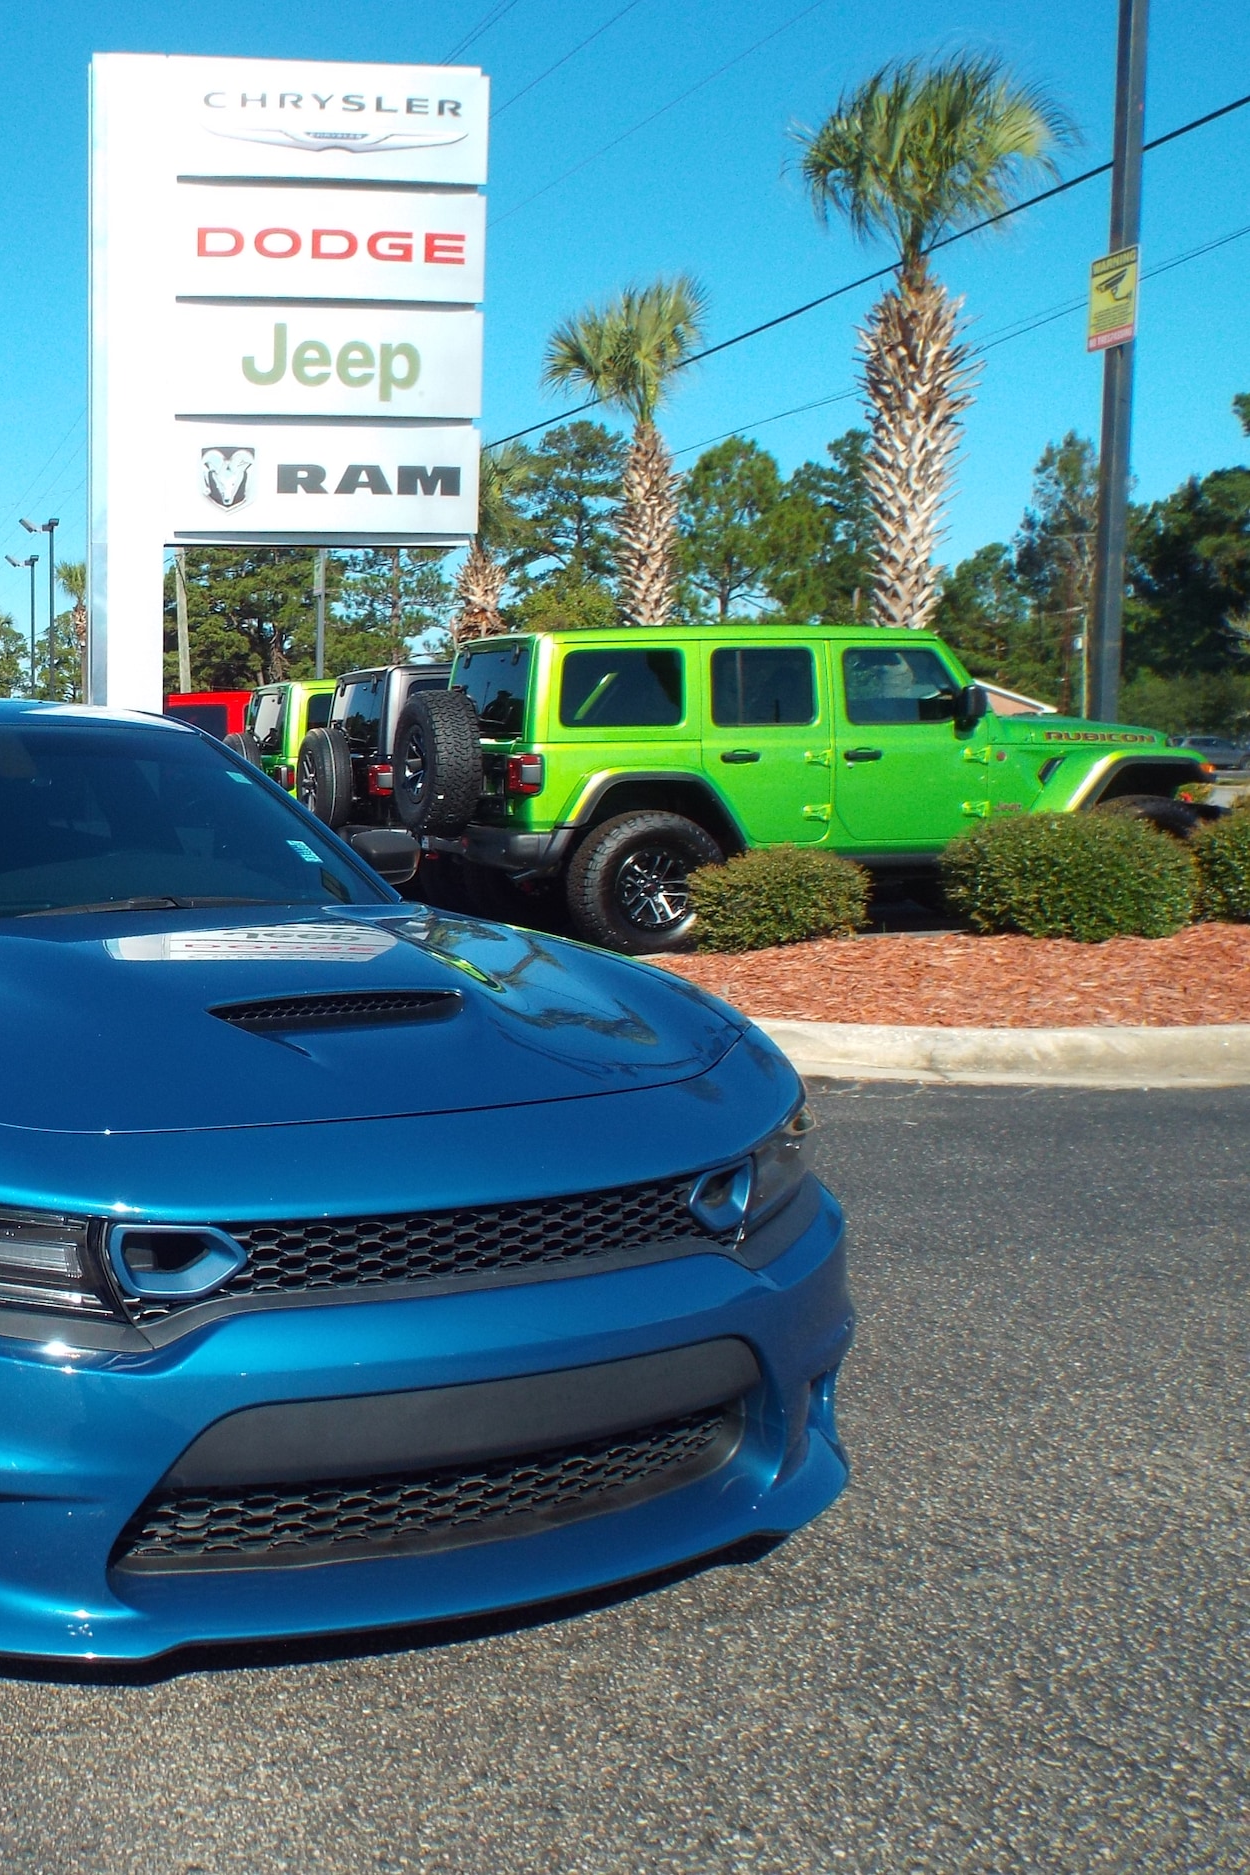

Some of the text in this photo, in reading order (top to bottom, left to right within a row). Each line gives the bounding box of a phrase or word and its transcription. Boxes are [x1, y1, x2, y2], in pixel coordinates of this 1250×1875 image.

[202, 91, 463, 118] CHRYSLER
[196, 227, 467, 265] DODGE
[241, 322, 422, 402] Jeep
[276, 464, 462, 497] RAM
[1044, 731, 1156, 743] RUBICON
